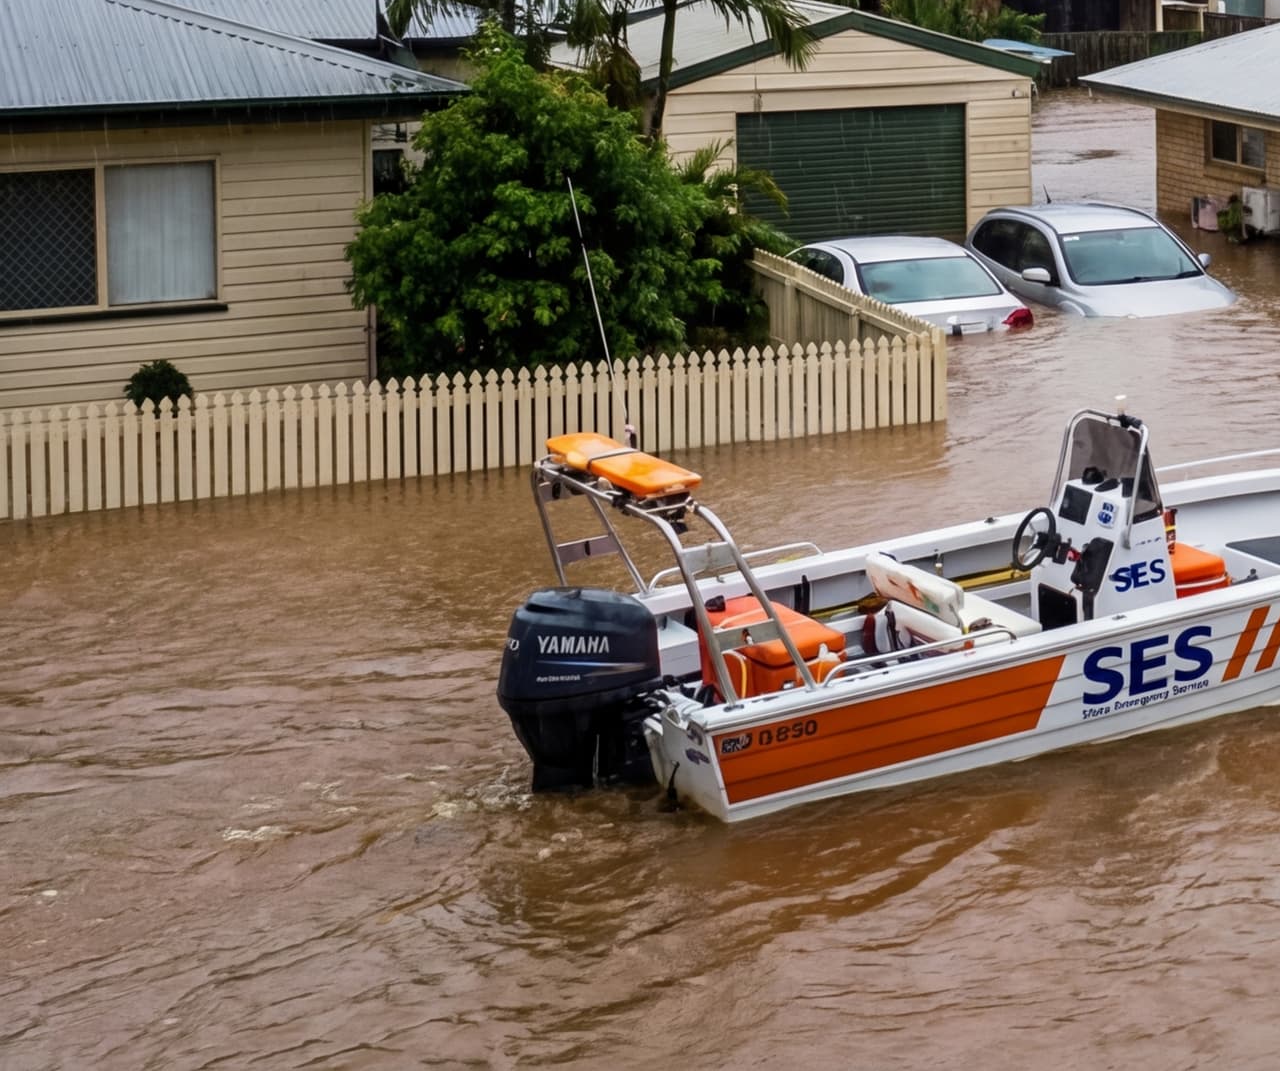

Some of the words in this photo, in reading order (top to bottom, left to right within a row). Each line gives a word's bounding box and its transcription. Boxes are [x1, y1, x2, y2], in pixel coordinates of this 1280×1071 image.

[1110, 559, 1165, 592] SES
[537, 635, 610, 654] YAMAHA
[1083, 626, 1213, 705] SES
